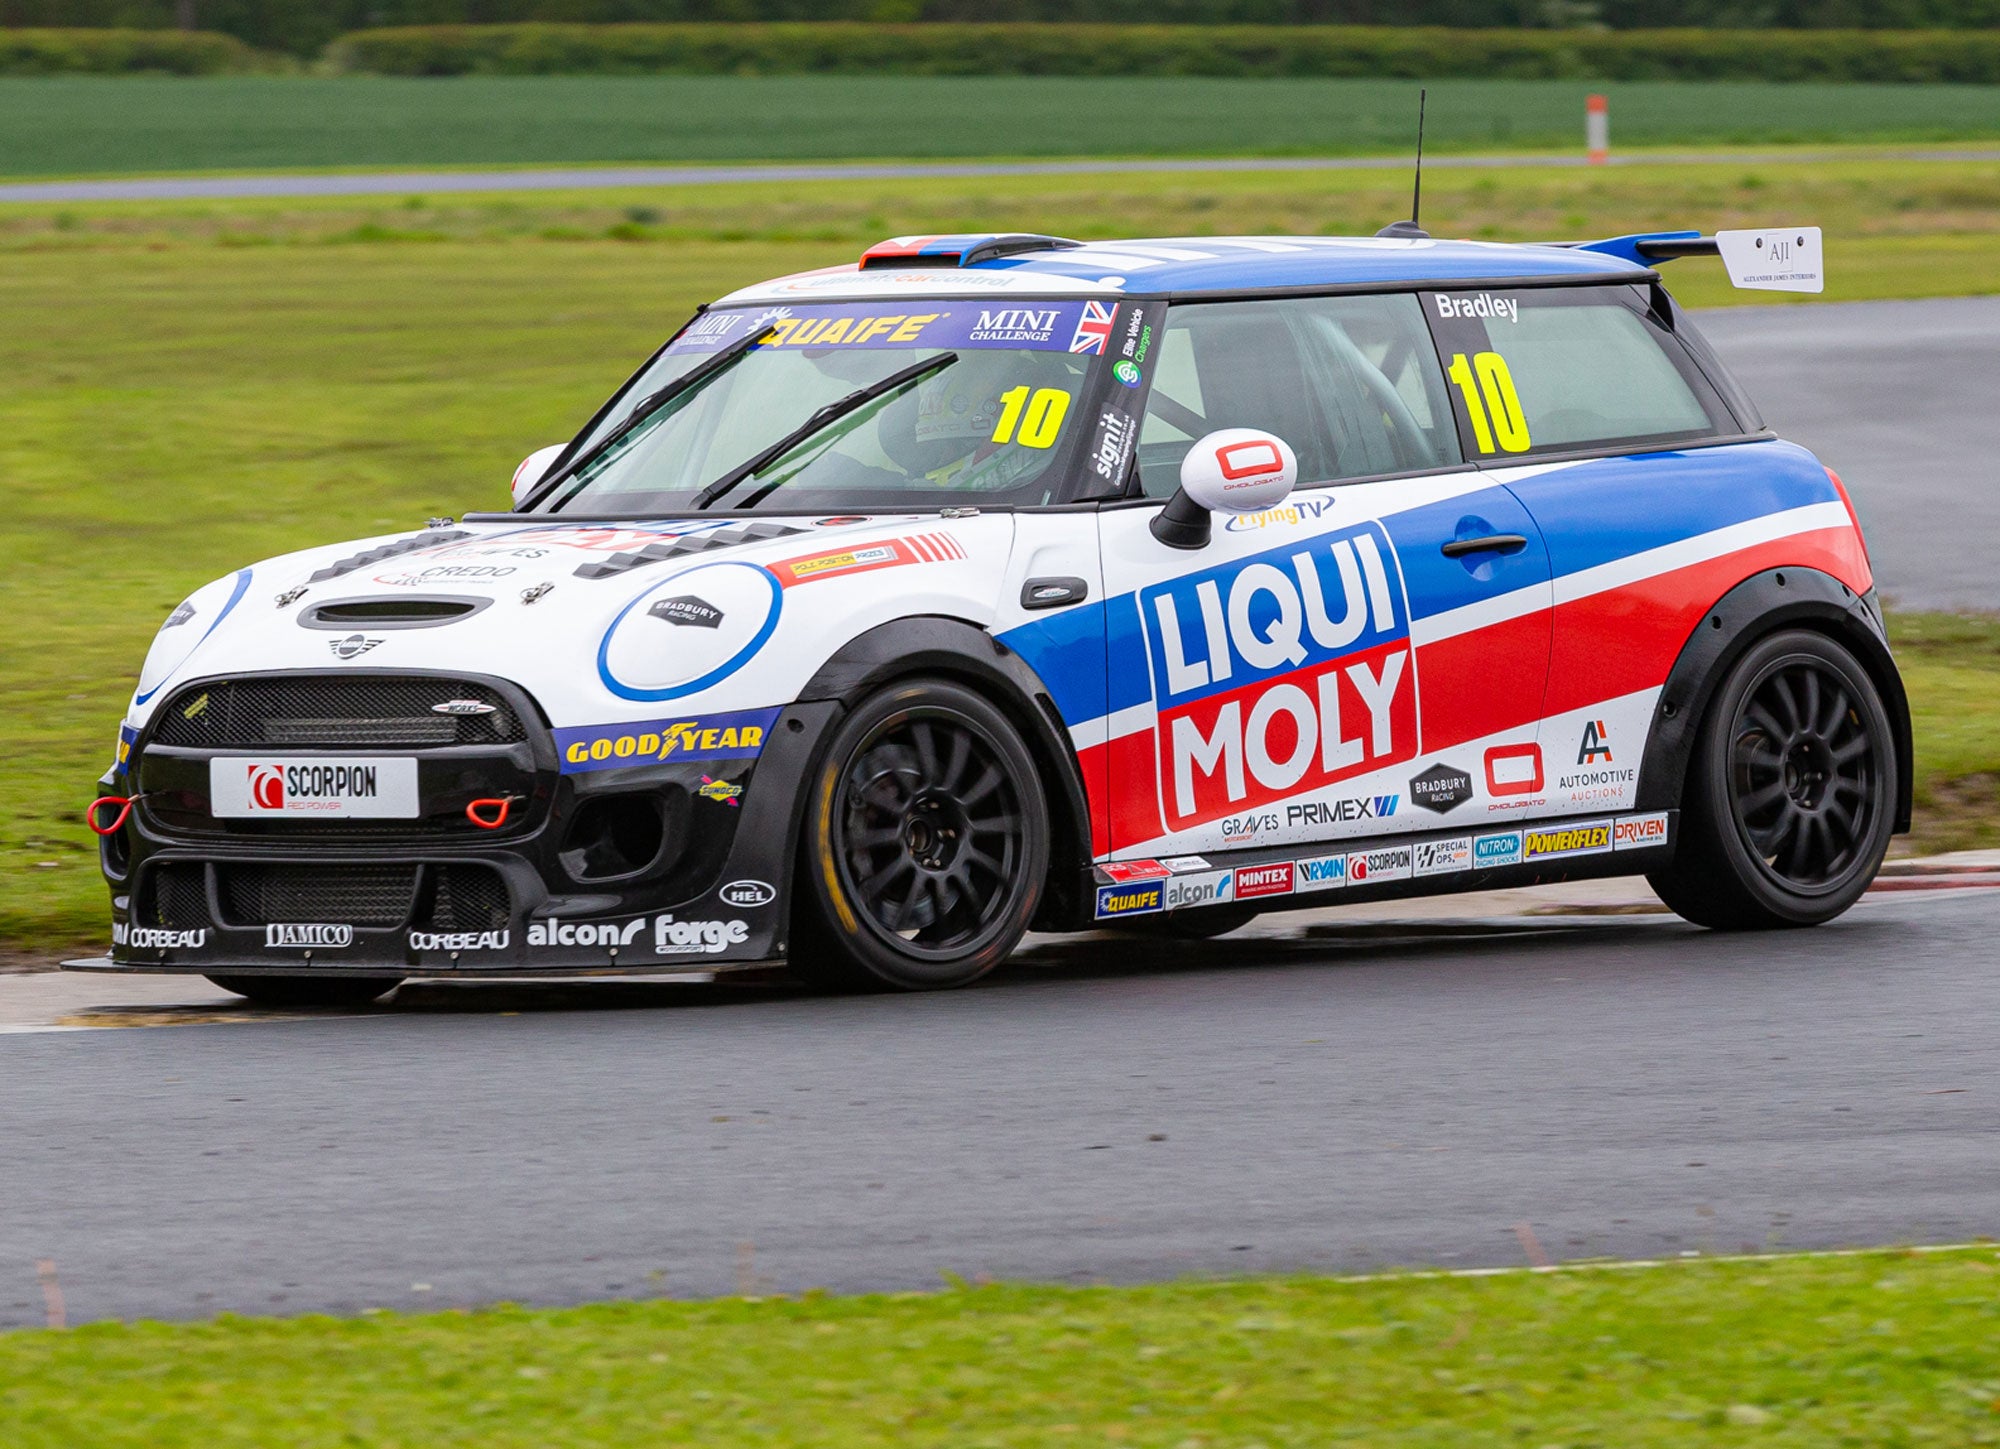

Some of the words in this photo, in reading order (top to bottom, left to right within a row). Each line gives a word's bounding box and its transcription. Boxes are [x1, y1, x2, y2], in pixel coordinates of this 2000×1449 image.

[1769, 242, 1789, 264] AJI
[1434, 294, 1518, 323] Bradley
[758, 311, 939, 348] QUAIFE
[976, 310, 1061, 332] MINI
[1127, 308, 1144, 337] Vehicle
[969, 330, 1050, 342] CHALLENGE
[1135, 325, 1152, 363] Chargers
[1448, 351, 1531, 454] 10
[991, 385, 1071, 449] 10
[1223, 475, 1284, 491] OMOLOGATO
[419, 566, 517, 577] CREDO
[794, 561, 817, 571] POLE
[655, 601, 718, 619] BRADBURY
[667, 610, 697, 621] RACING
[1153, 533, 1396, 697] LIQUI
[1171, 648, 1408, 818] MOLY
[287, 766, 376, 797] SCORPION
[701, 784, 740, 796] SUNOCO
[1415, 777, 1466, 794] BRADBURY
[1559, 769, 1634, 789] AUTOMOTIVE
[1431, 792, 1455, 802] RACING
[1488, 799, 1546, 811] OMOLOGATO
[1571, 787, 1624, 801] AUCTIONS
[287, 801, 306, 810] RED
[307, 801, 343, 810] POWER
[1286, 797, 1373, 827] PRIMEX
[1221, 813, 1279, 836] GRAVES
[1615, 819, 1664, 842] DRIVEN
[1436, 840, 1467, 852] SPECIAL
[1479, 839, 1514, 853] NITRON
[1525, 826, 1610, 857] POWERFLEX
[1309, 858, 1345, 881] RYAN
[1368, 850, 1410, 872] SCORPION
[1238, 868, 1288, 887] MINTEX
[731, 891, 766, 902] HEL
[1107, 890, 1159, 912] QUAIFE
[1168, 881, 1214, 904] alcon
[130, 928, 205, 948] CORBEAU
[265, 924, 350, 947] DAMICO
[409, 930, 509, 950] CORBEAU
[655, 915, 749, 953] forge
